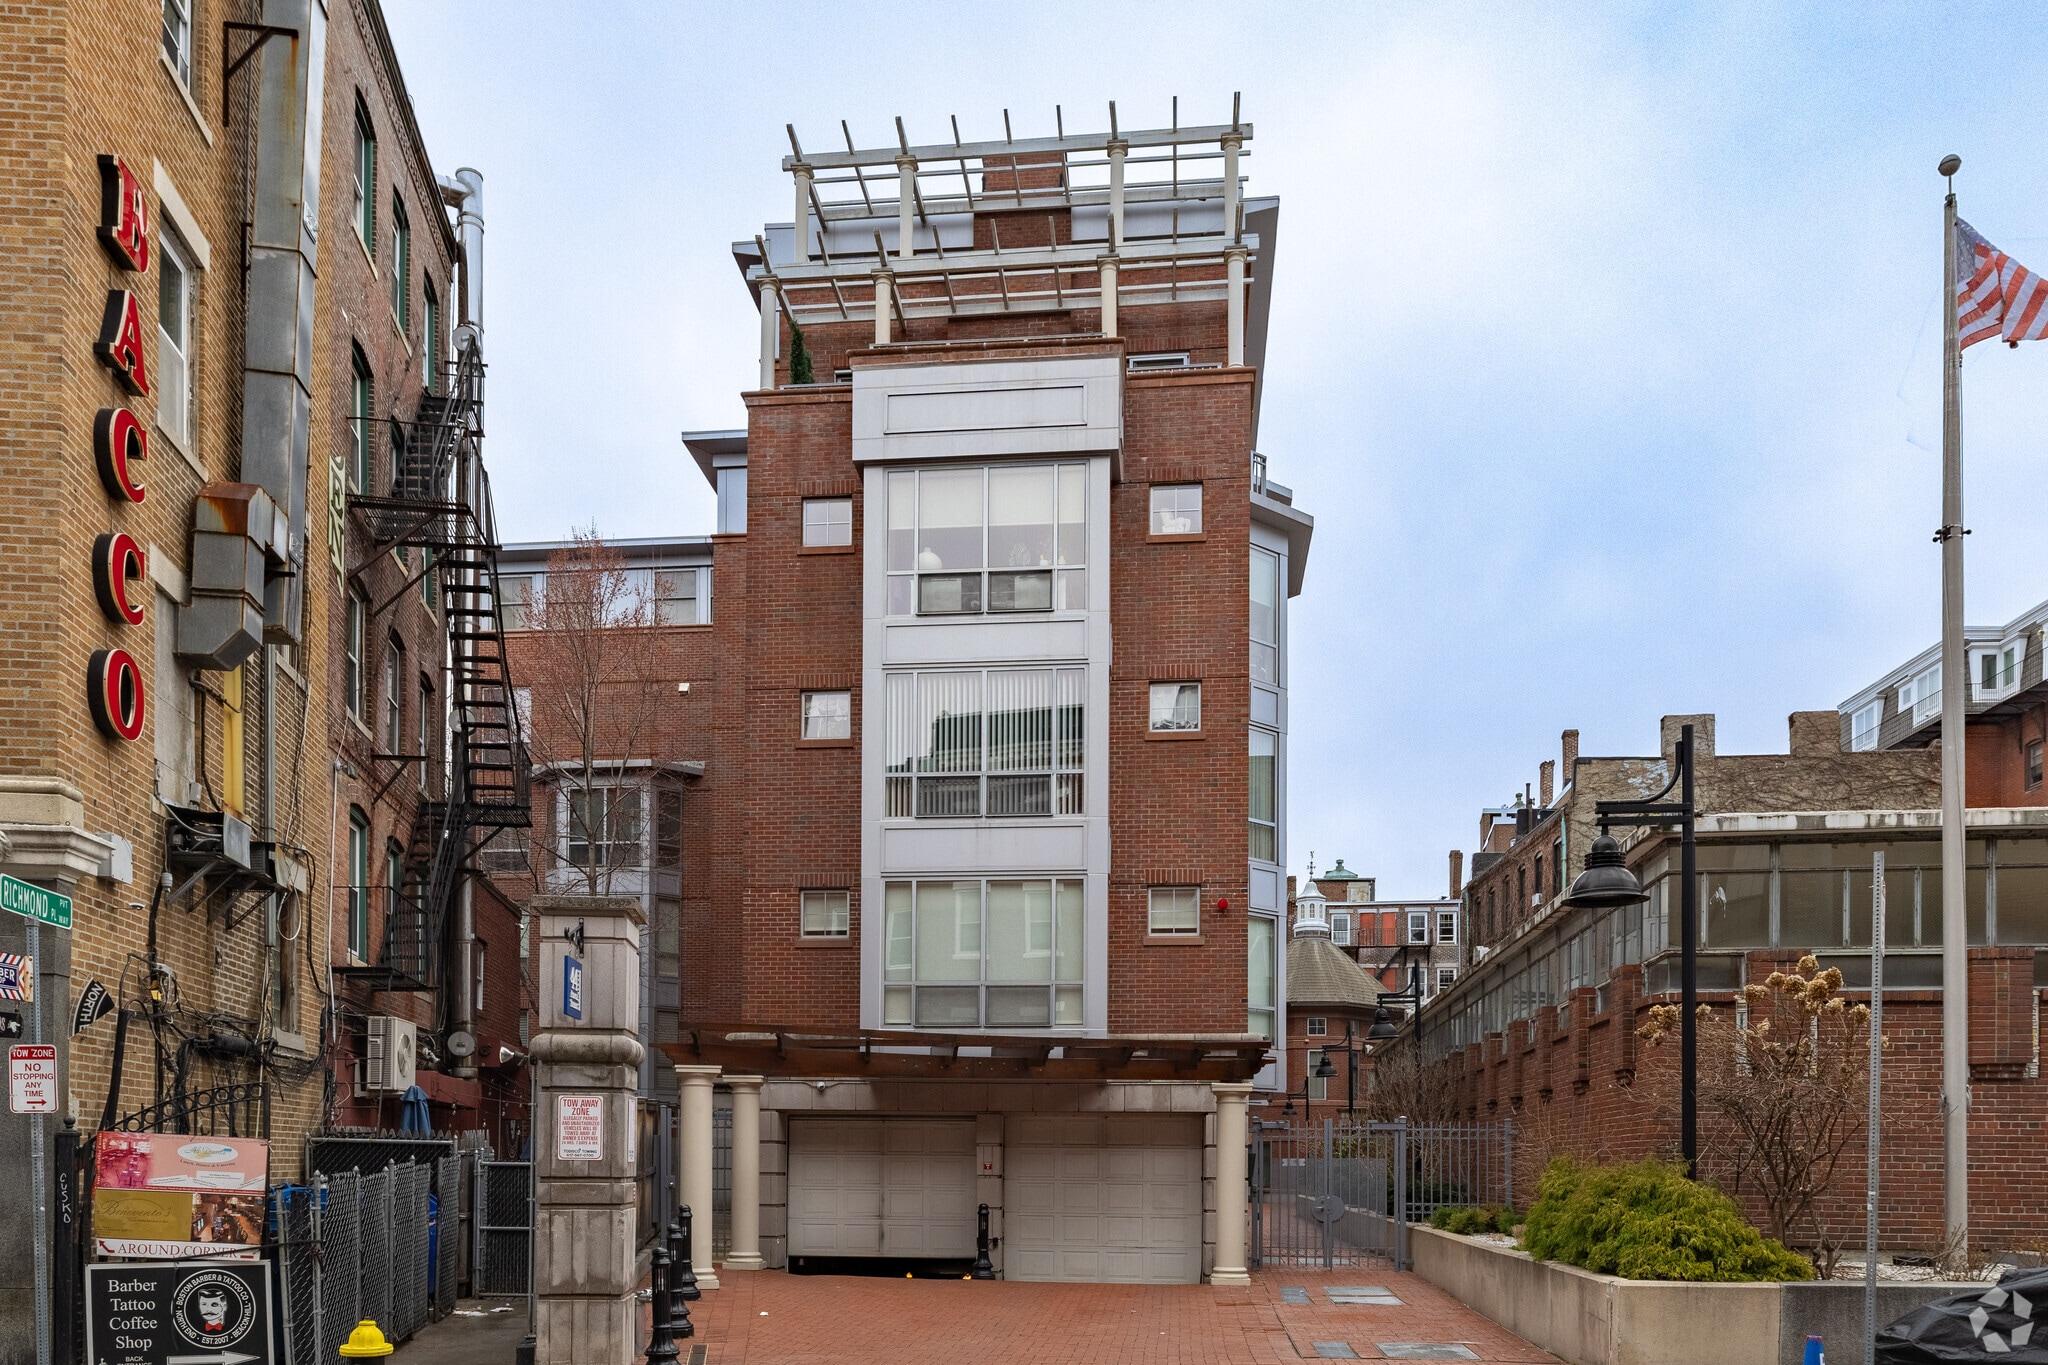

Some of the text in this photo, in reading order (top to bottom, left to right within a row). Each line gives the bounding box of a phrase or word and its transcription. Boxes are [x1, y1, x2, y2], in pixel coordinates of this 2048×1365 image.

[90, 154, 150, 742] BACCO
[3, 880, 57, 921] RICHMOND PL
[60, 899, 68, 909] PVT
[59, 915, 69, 925] WAY
[80, 983, 104, 1022] NORTH
[32, 1049, 54, 1057] ZONE
[24, 1063, 42, 1072] NO
[563, 1099, 599, 1107] TOW AWAY
[118, 1243, 237, 1258] AROUND CORNER
[108, 1279, 157, 1293] Barber
[176, 1283, 193, 1306] BOSTON
[191, 1274, 216, 1286] BARBER
[222, 1276, 244, 1295] TATTOO
[240, 1292, 248, 1301] CO
[110, 1298, 156, 1312] Tattoo
[109, 1317, 158, 1330] Coffee
[176, 1310, 197, 1339] NORTH END
[232, 1318, 251, 1337] BEACON
[116, 1336, 152, 1351] Shop
